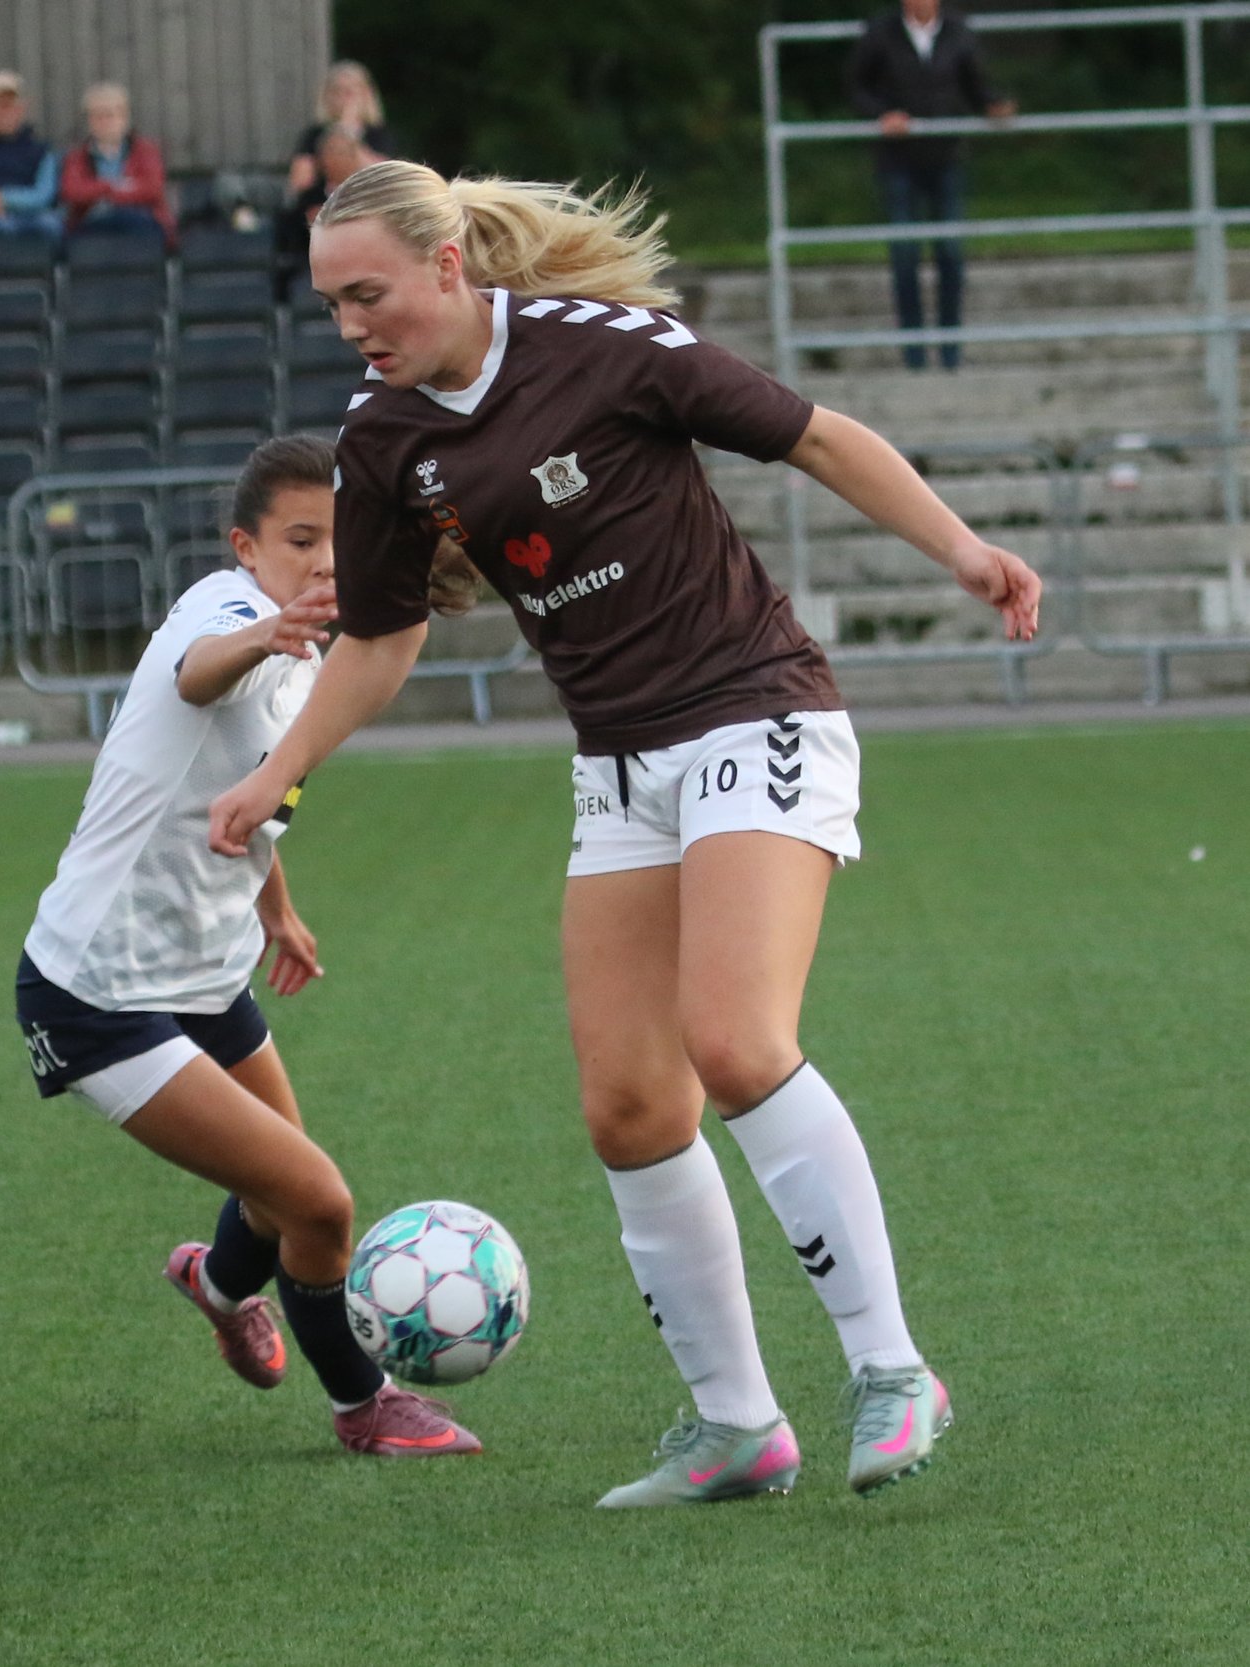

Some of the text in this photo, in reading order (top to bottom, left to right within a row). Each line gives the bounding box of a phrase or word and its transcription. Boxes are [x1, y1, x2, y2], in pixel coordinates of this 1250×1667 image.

[545, 561, 625, 610] Elektro
[698, 758, 738, 801] 10
[573, 795, 610, 817] DEN
